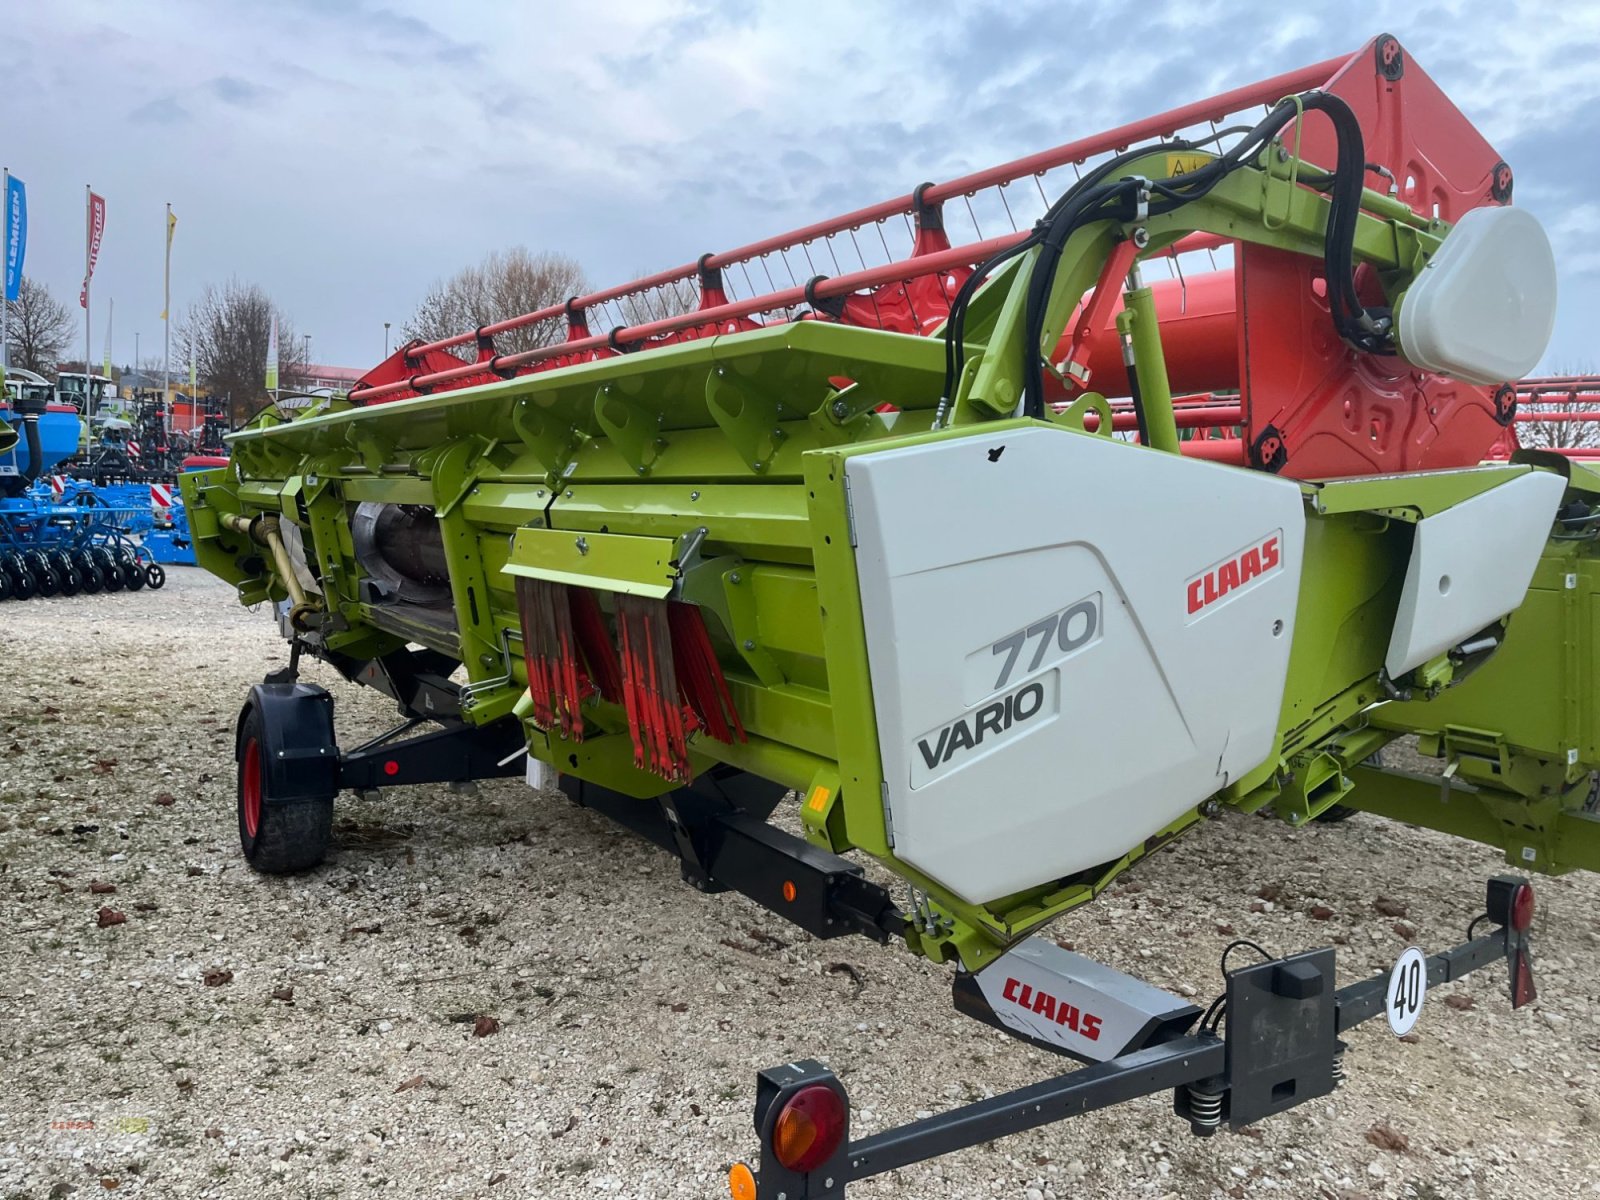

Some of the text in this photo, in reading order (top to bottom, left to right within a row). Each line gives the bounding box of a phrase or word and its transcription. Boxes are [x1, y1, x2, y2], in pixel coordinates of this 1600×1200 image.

[9, 191, 20, 268] LEMKEN
[1188, 537, 1278, 614] CLAAS
[993, 601, 1097, 690] 770
[918, 683, 1043, 770] VARIO
[1003, 976, 1103, 1041] CLAAS
[1394, 959, 1420, 1019] 40
